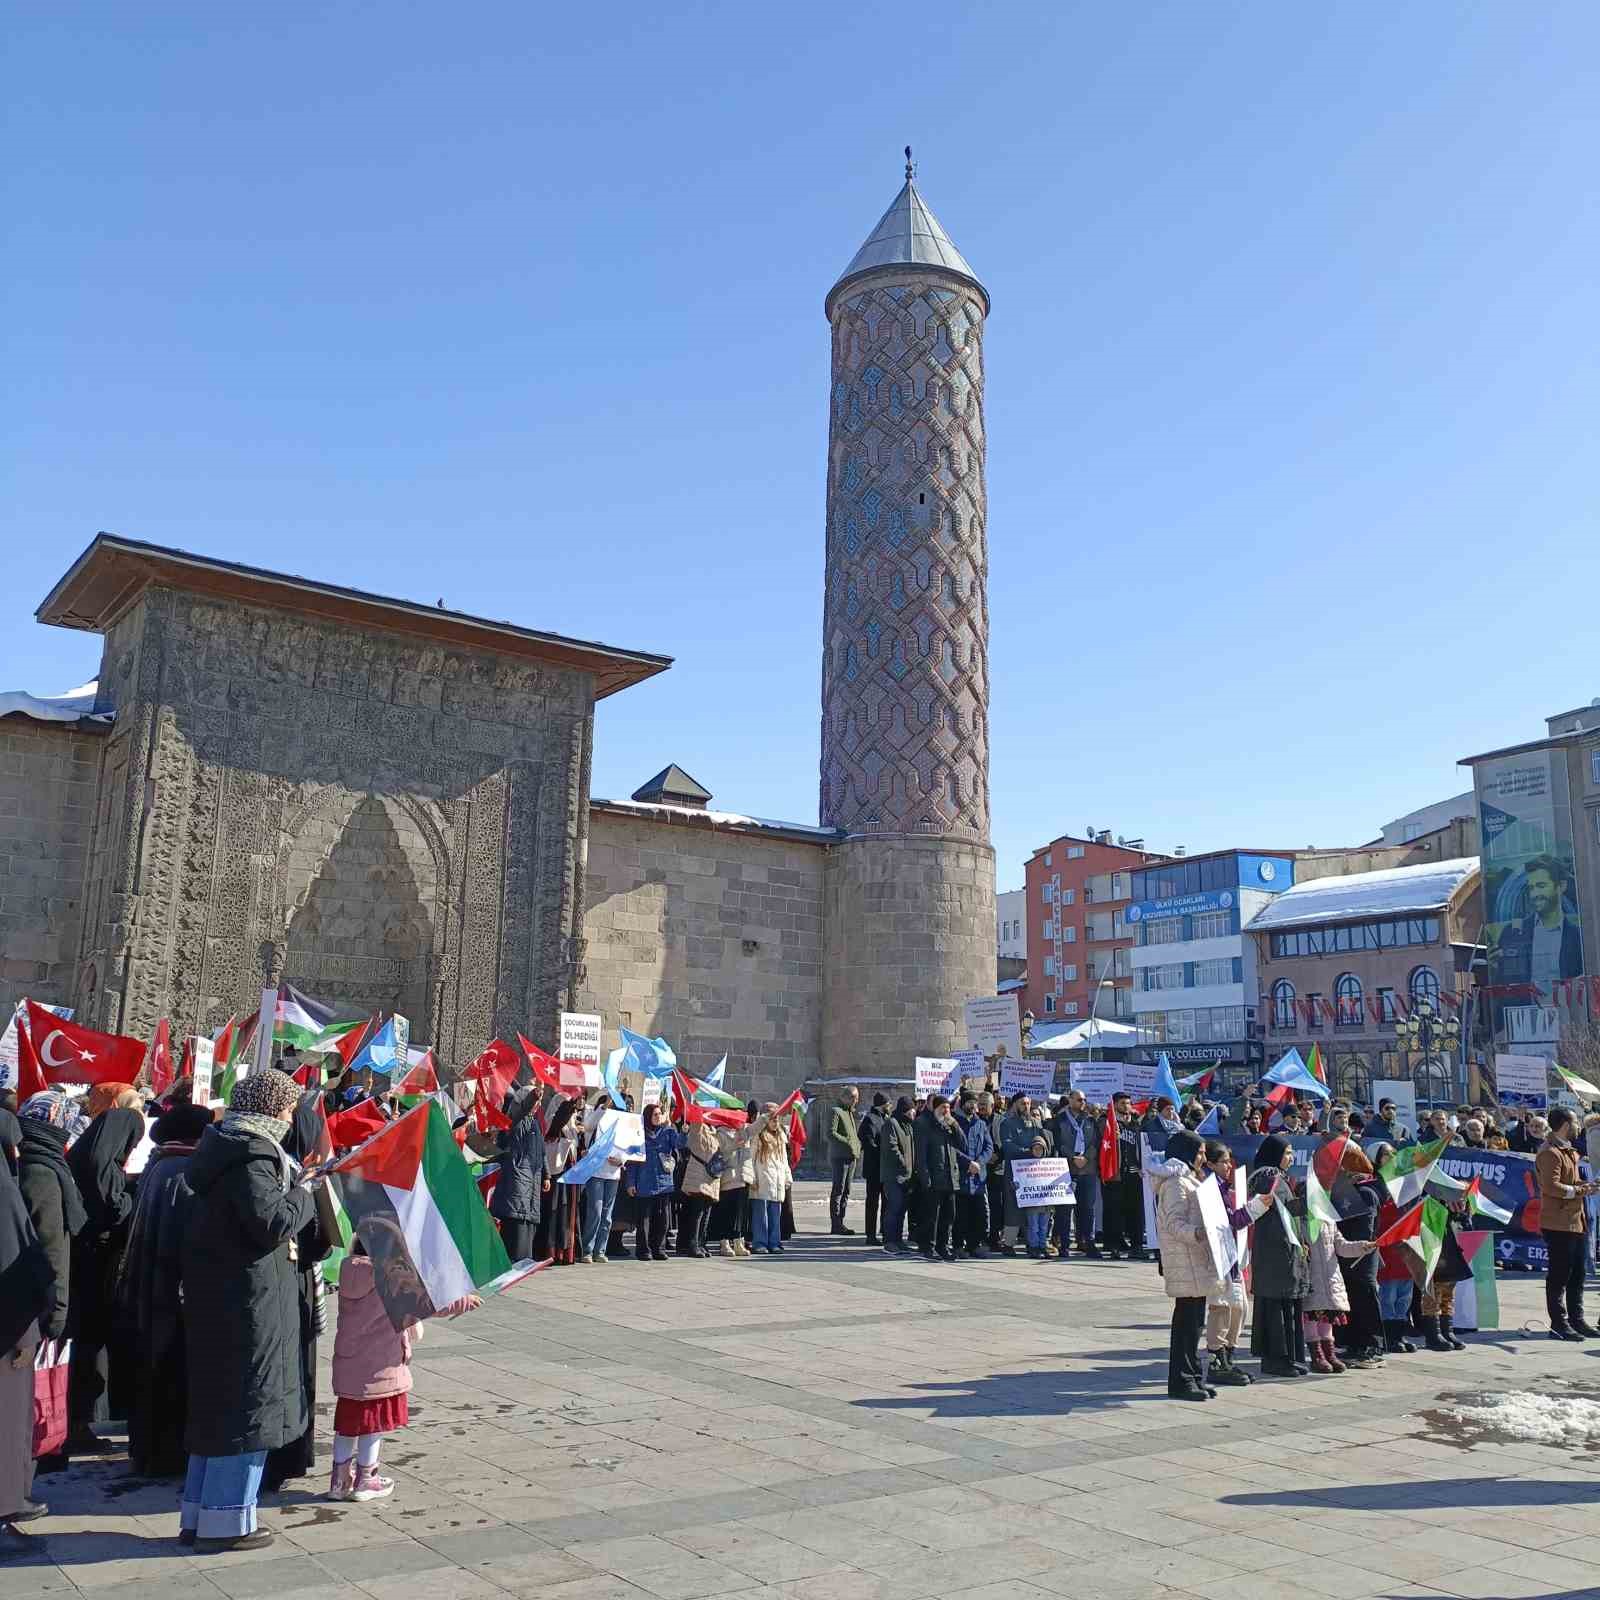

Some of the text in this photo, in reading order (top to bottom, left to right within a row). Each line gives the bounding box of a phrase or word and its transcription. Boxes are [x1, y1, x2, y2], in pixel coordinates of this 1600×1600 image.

[1174, 895, 1206, 906] OCAKLARI
[1179, 901, 1219, 914] BAŞKANLIĞI
[1176, 1048, 1231, 1059] COLLECTION
[1020, 1191, 1065, 1200] OTURAMAYIZ
[1528, 1246, 1549, 1261] ERZ
